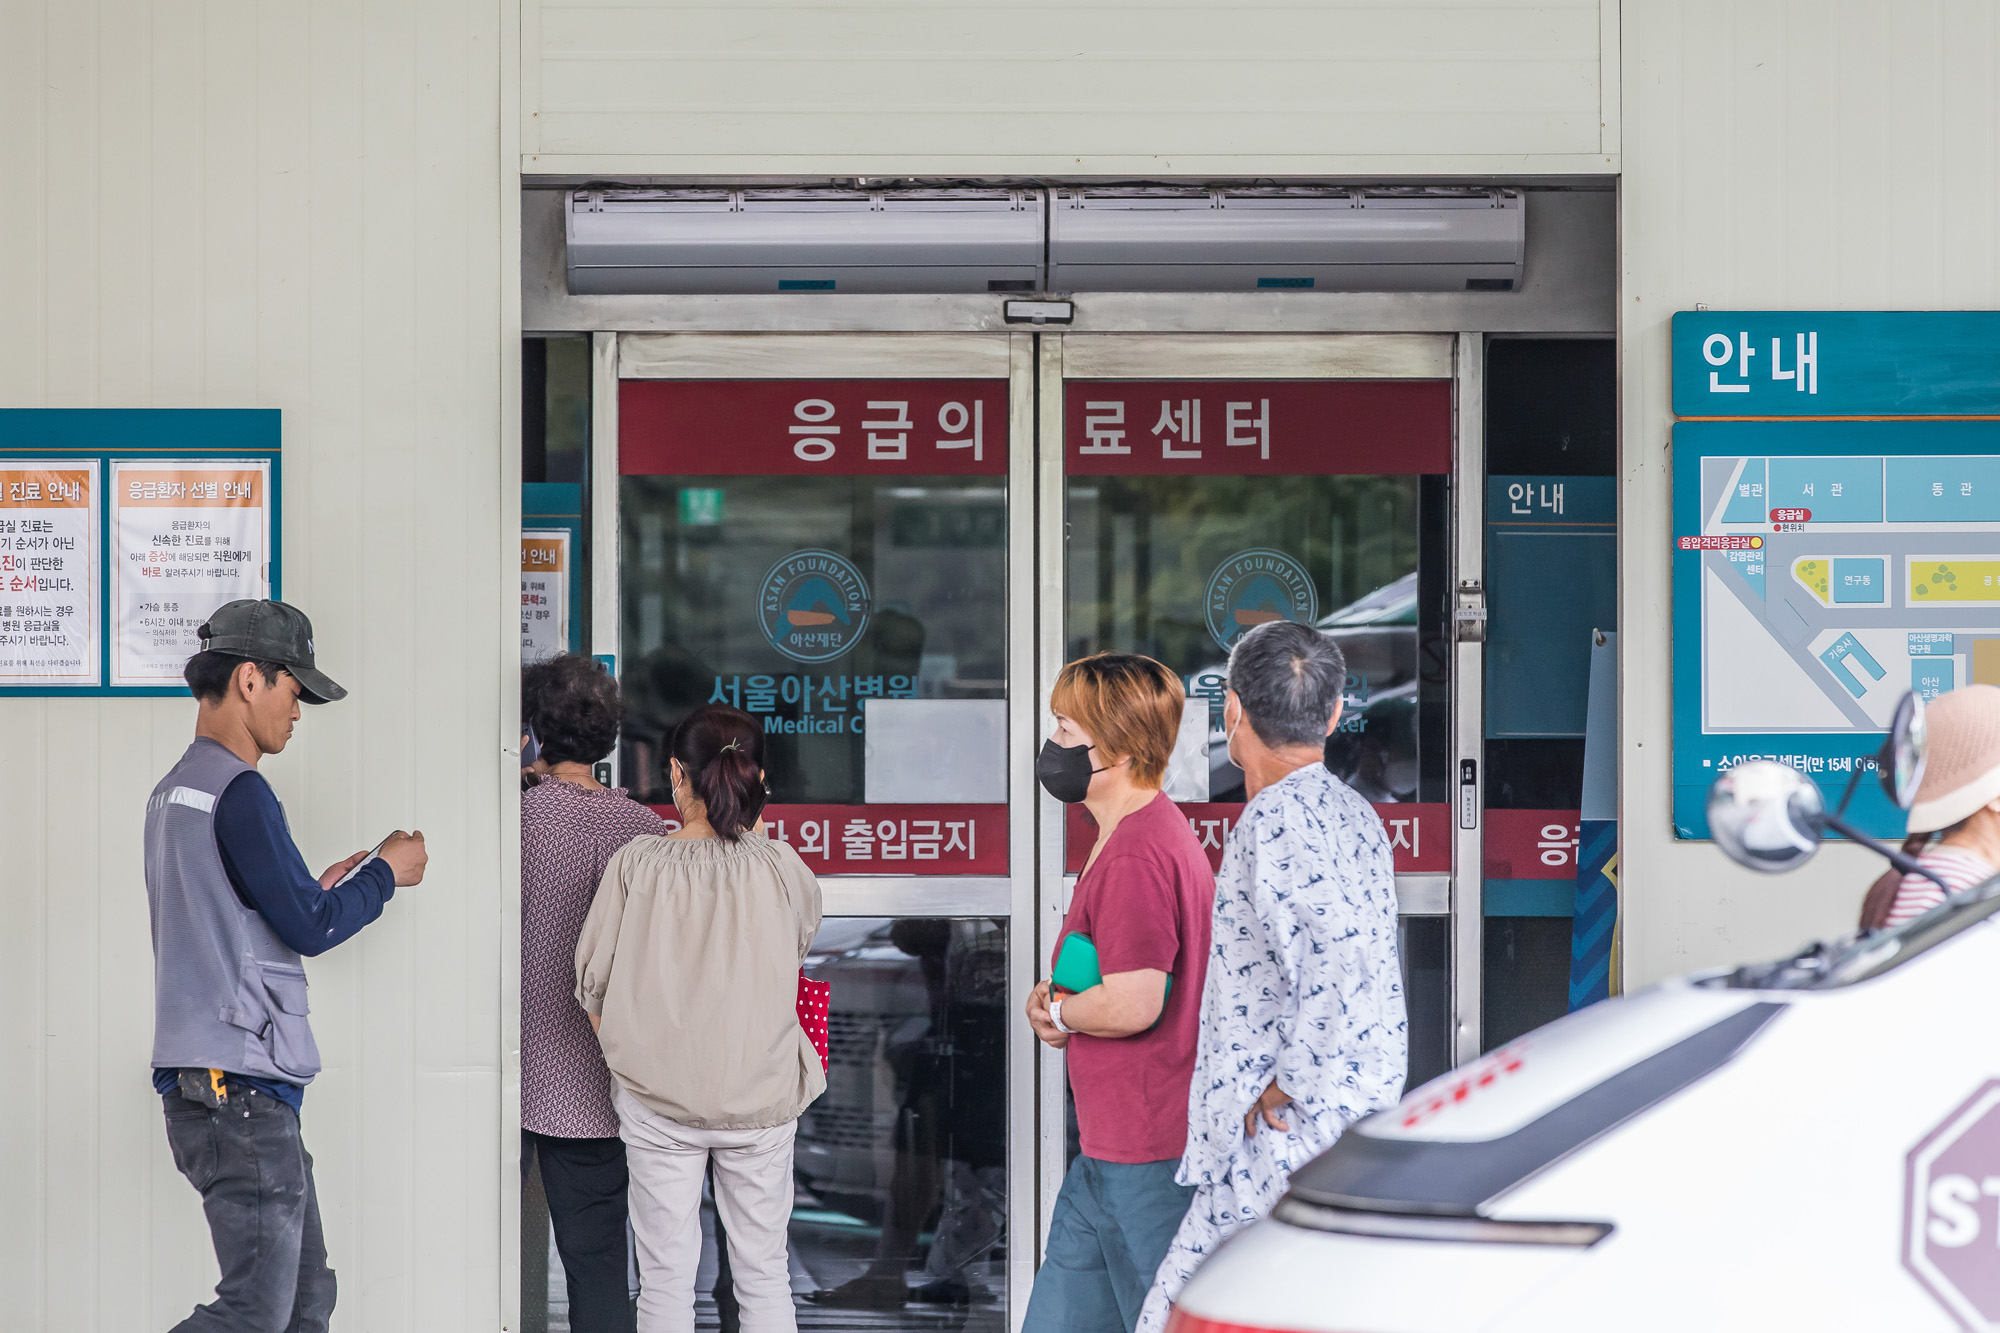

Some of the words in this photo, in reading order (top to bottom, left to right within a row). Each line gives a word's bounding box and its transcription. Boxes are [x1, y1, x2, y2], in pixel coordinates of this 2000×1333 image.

[1702, 332, 1817, 394] 안내
[10, 481, 42, 501] 진료
[48, 481, 80, 501] 안내
[129, 482, 186, 499] 응급환자
[190, 482, 218, 499] 선별
[223, 482, 252, 499] 안내
[1739, 483, 1763, 497] 별관
[1508, 483, 1564, 515] 안내
[1777, 510, 1804, 520] 응급실
[21, 520, 53, 533] 진료는
[171, 521, 211, 530] 응급환자의
[1782, 523, 1805, 532] 현위치
[15, 537, 48, 550] 순서가
[52, 537, 74, 550] 아닌
[152, 535, 181, 546] 신속한
[185, 535, 211, 546] 진료를
[214, 536, 231, 546] 위해
[1682, 537, 1750, 549] 음압격리응급실
[130, 553, 145, 561] 아래
[149, 551, 176, 562] 증상에
[179, 552, 210, 562] 해당되면
[213, 551, 252, 562] 직원에게
[531, 549, 556, 564] 안내
[1729, 552, 1764, 561] 감염관리
[0, 555, 25, 571] 진이
[30, 557, 64, 571] 판단한
[142, 567, 162, 578] 바로
[165, 568, 204, 577] 알려주시기
[207, 568, 240, 578] 바랍니다.
[1746, 565, 1764, 574] 센터
[10, 575, 74, 592] 순서입니다.
[530, 582, 545, 590] 위해
[766, 575, 786, 611] ASAN
[788, 558, 861, 612] FOUNDATION
[1213, 574, 1234, 611] ASAN
[1235, 558, 1308, 611] FOUNDATION
[1844, 575, 1871, 586] 연구동
[16, 606, 52, 617] 원하시는
[56, 606, 74, 617] 경우
[163, 603, 179, 611] 통증
[535, 611, 550, 619] 경우
[3, 620, 21, 632] 병원
[24, 620, 60, 632] 응급실을
[144, 618, 165, 627] 6시간
[168, 618, 184, 627] 이내
[183, 629, 198, 637] 언어
[1909, 634, 1952, 643] 아산생명과학
[30, 635, 69, 646] 바랍니다.
[790, 632, 842, 648] 아산재단
[1828, 638, 1853, 660] 기숙사
[1909, 645, 1931, 653] 연구원
[1922, 677, 1940, 686] 아산
[708, 675, 918, 712] 서울아산병원
[764, 715, 843, 734] Medical
[850, 716, 866, 734] C
[1827, 757, 1851, 772] 15세
[798, 819, 830, 860] 외
[841, 819, 976, 860] 출입금지
